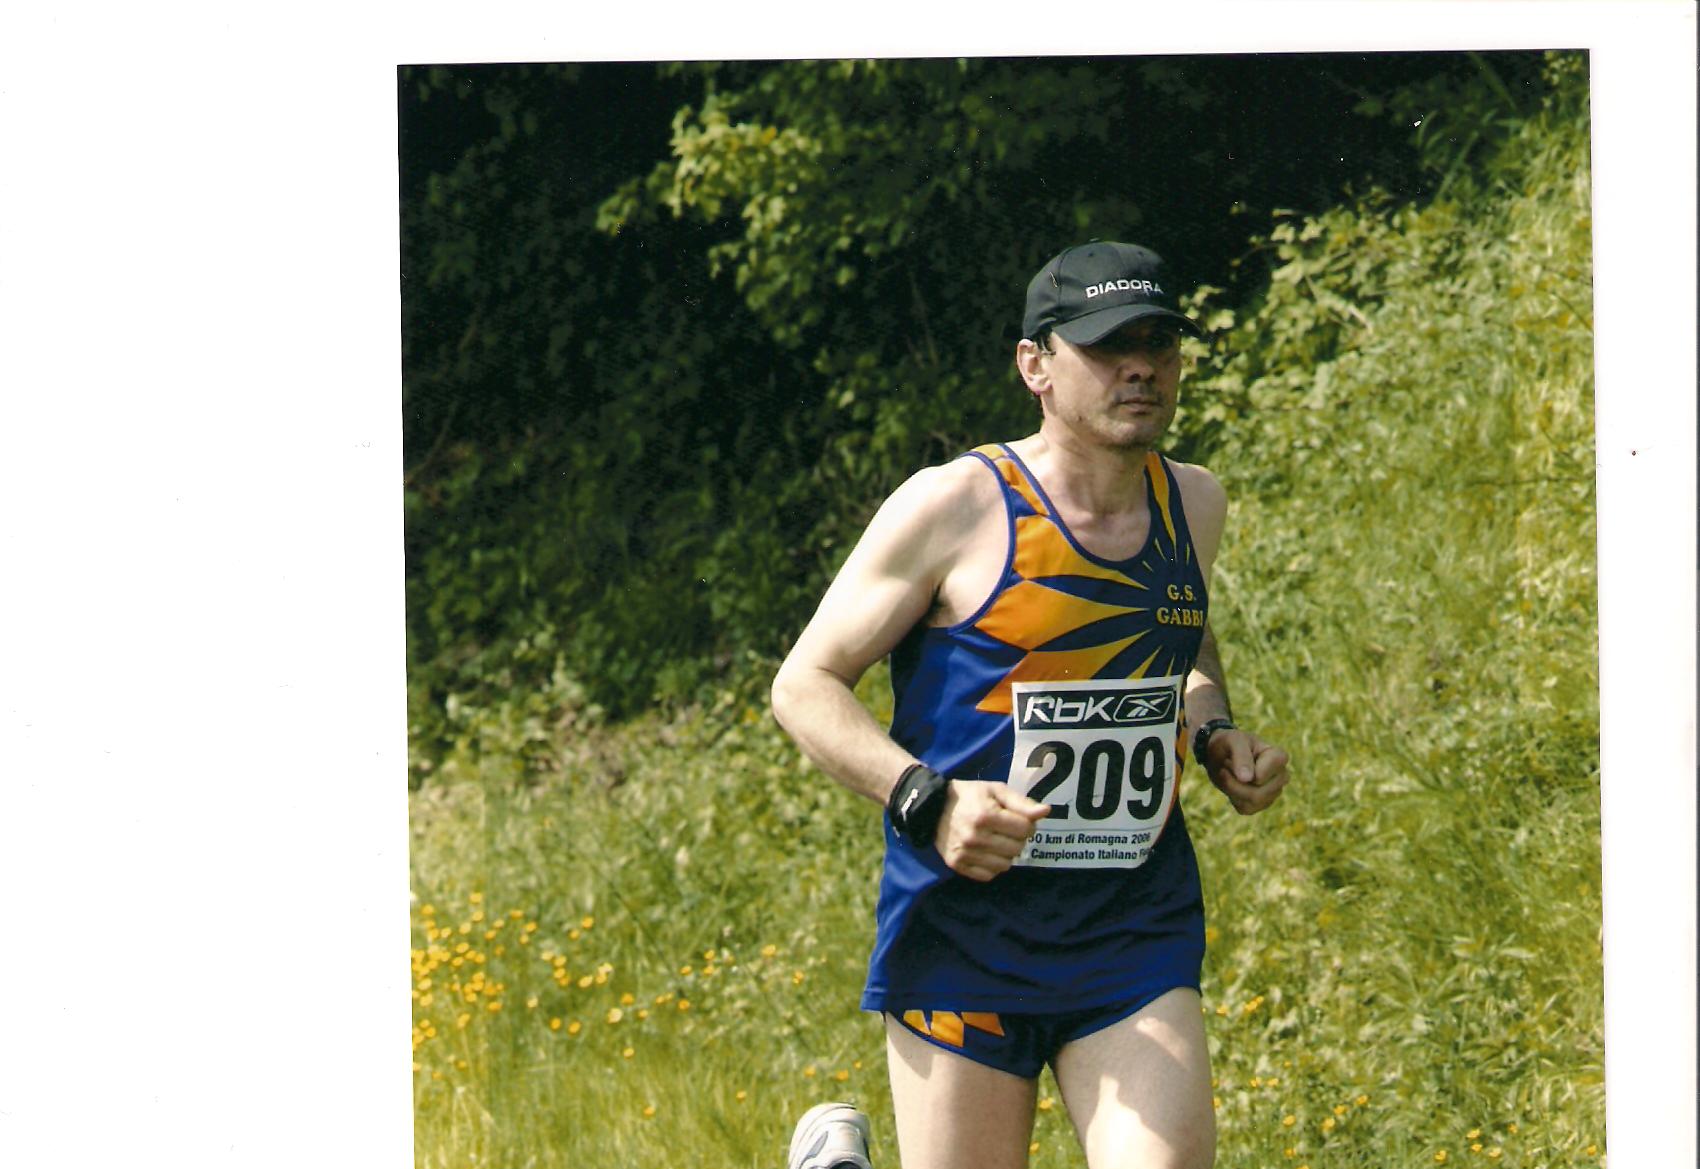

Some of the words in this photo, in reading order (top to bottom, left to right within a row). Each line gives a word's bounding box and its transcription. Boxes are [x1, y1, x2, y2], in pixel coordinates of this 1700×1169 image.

[1085, 279, 1164, 299] DIADORA
[1167, 584, 1197, 602] G.S.
[1156, 607, 1203, 627] GABBI
[1025, 736, 1166, 820] 209
[1045, 834, 1062, 844] km
[1065, 834, 1075, 844] di
[1078, 833, 1128, 846] Romagna
[1031, 848, 1095, 862] Campionato
[1098, 849, 1137, 860] Italiano
